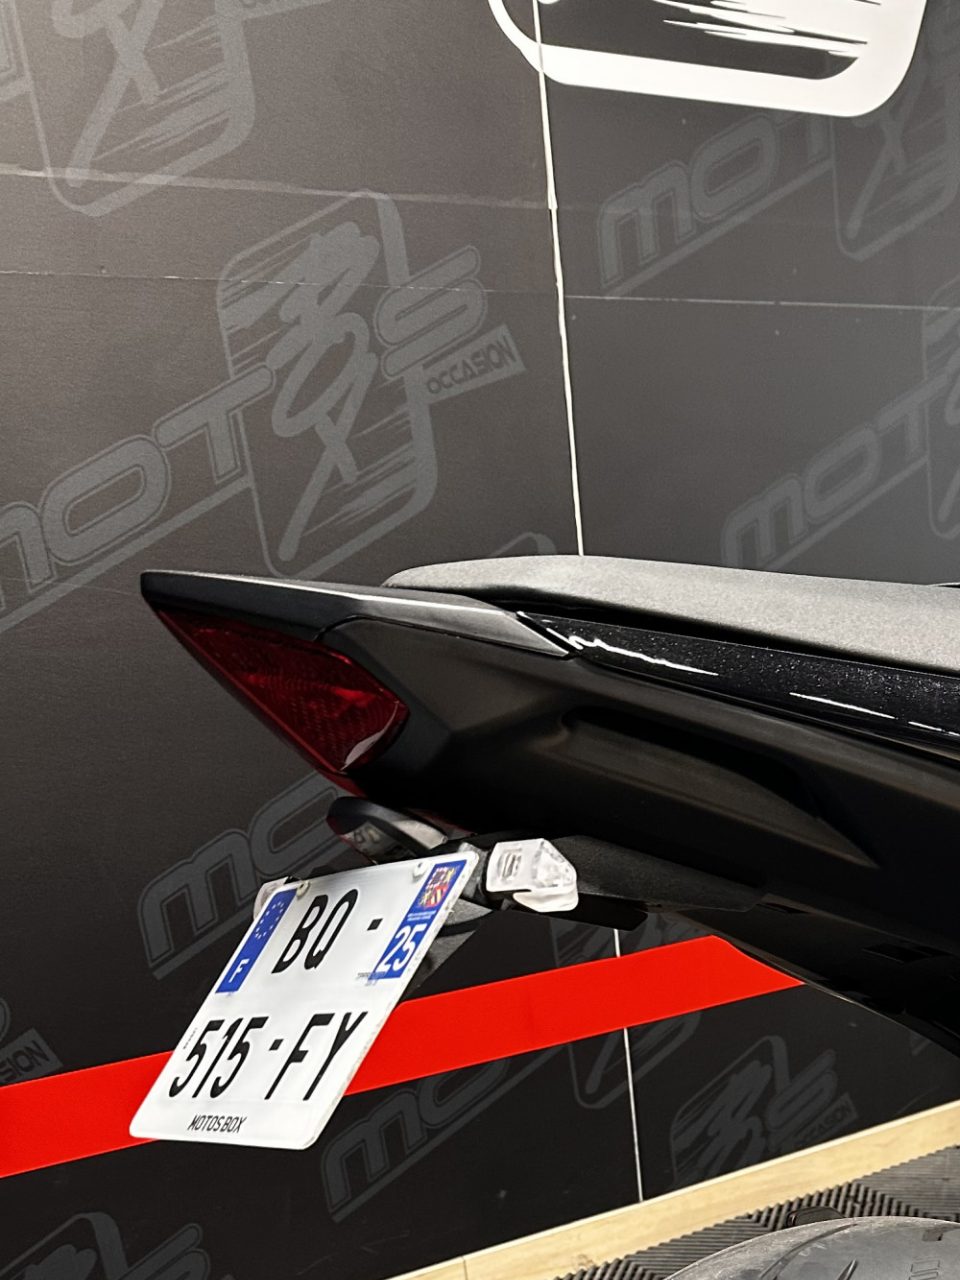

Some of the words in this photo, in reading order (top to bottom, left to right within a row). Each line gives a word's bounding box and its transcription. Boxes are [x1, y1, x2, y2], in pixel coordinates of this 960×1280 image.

[426, 335, 517, 396] OCCASION
[228, 958, 251, 983] F
[374, 923, 428, 972] 25
